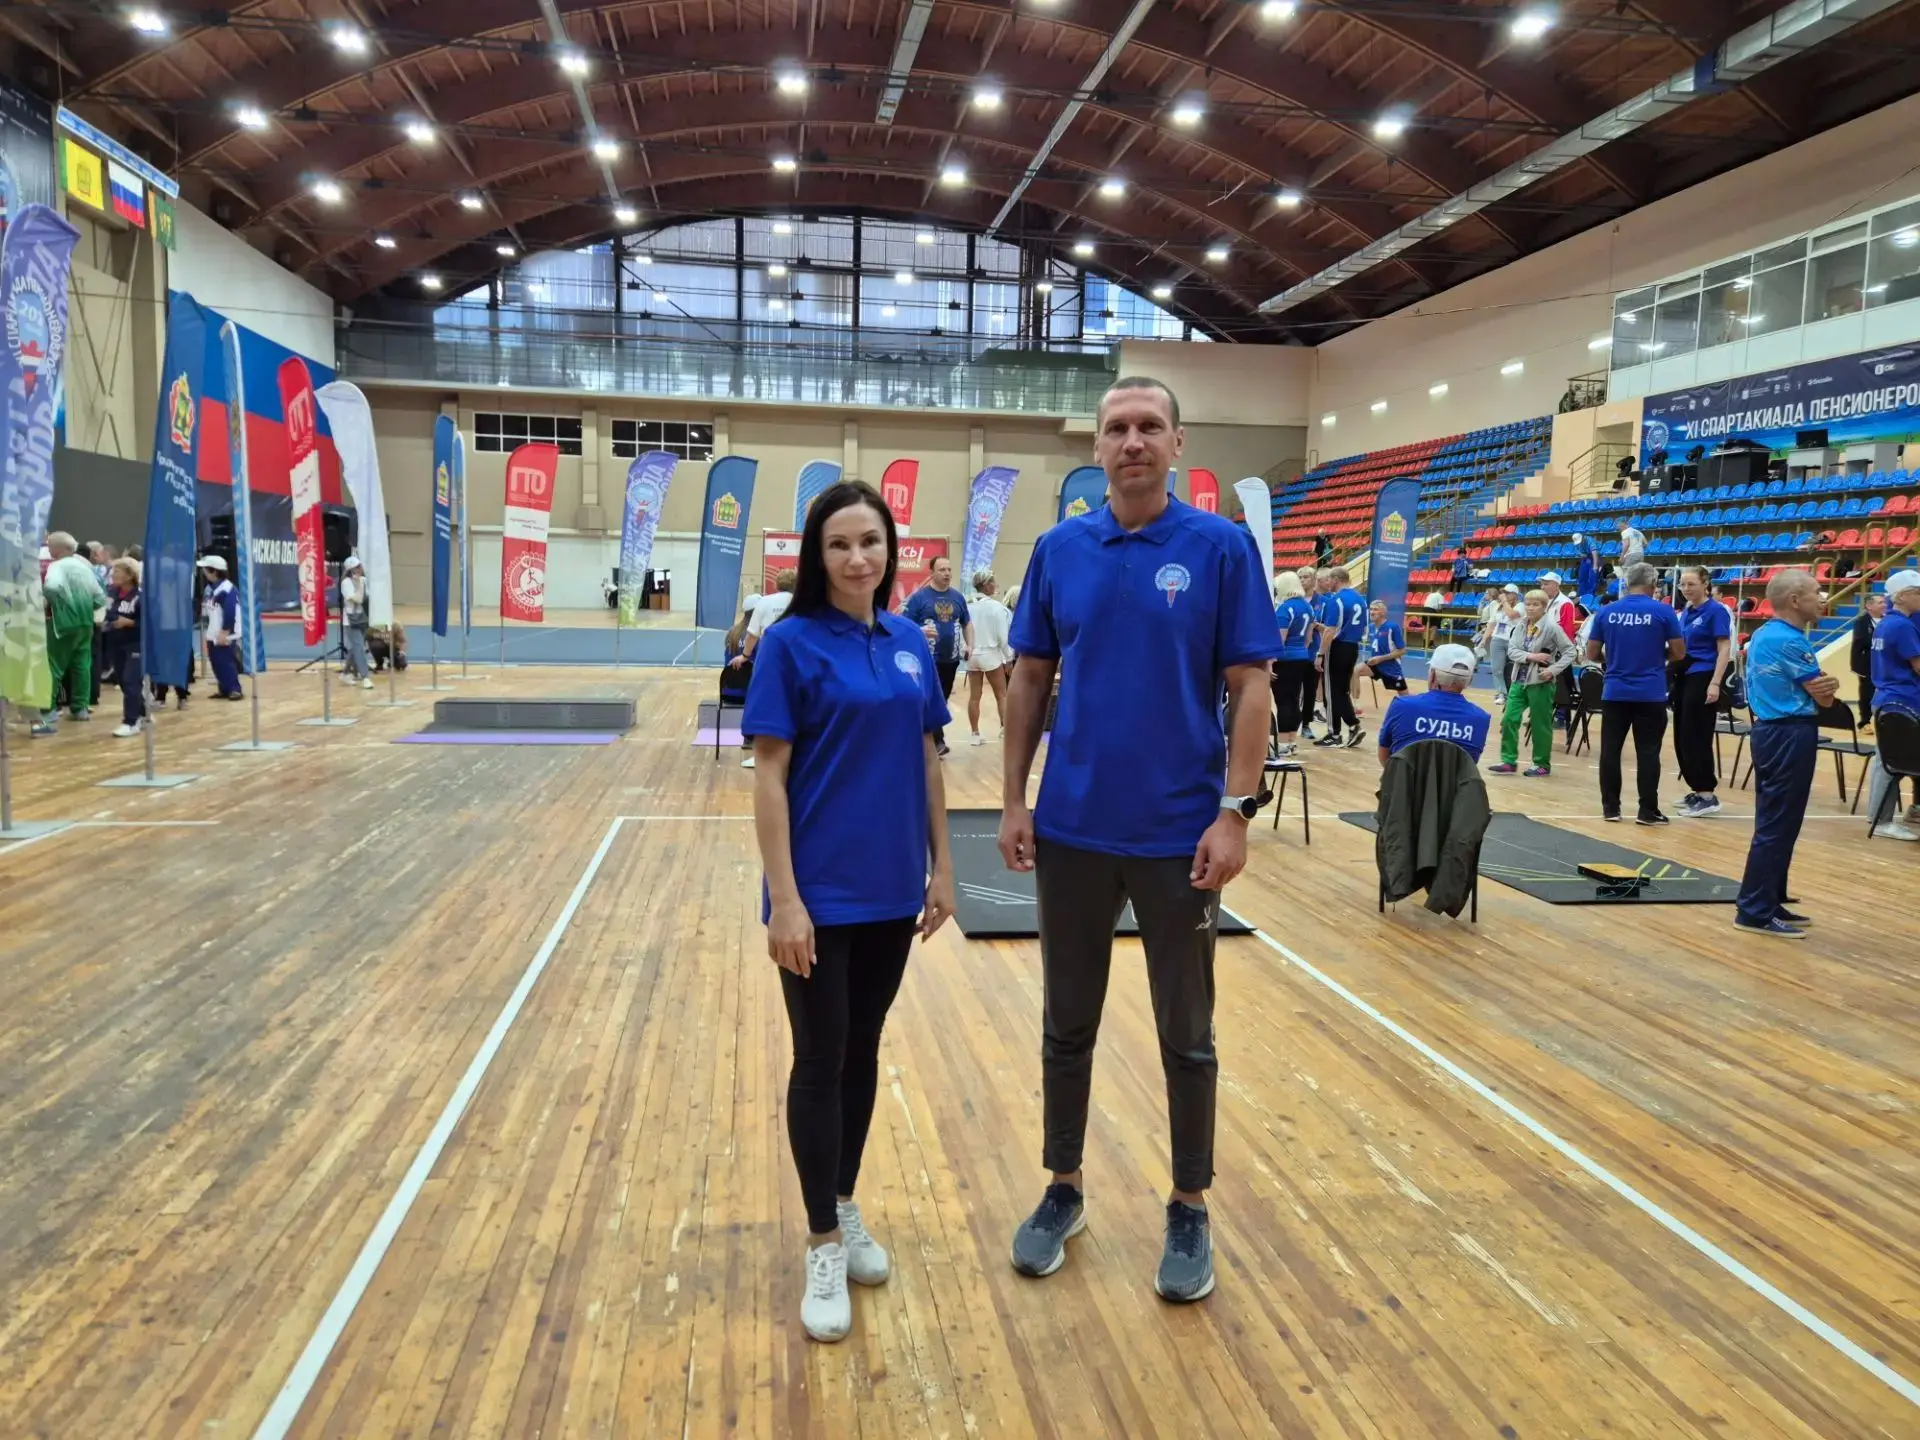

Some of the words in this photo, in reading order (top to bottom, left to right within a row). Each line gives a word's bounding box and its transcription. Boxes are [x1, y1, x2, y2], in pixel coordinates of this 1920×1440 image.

[1685, 419, 1699, 440] XI
[1700, 402, 1803, 438] СПАРТАКИАДА
[253, 538, 280, 564] НСКАЯ
[281, 540, 298, 565] ОБЛ
[1352, 604, 1362, 625] 2
[1608, 612, 1652, 626] СУДЬЯ
[1372, 639, 1379, 652] 4
[1415, 716, 1473, 741] СУДЬЯ
